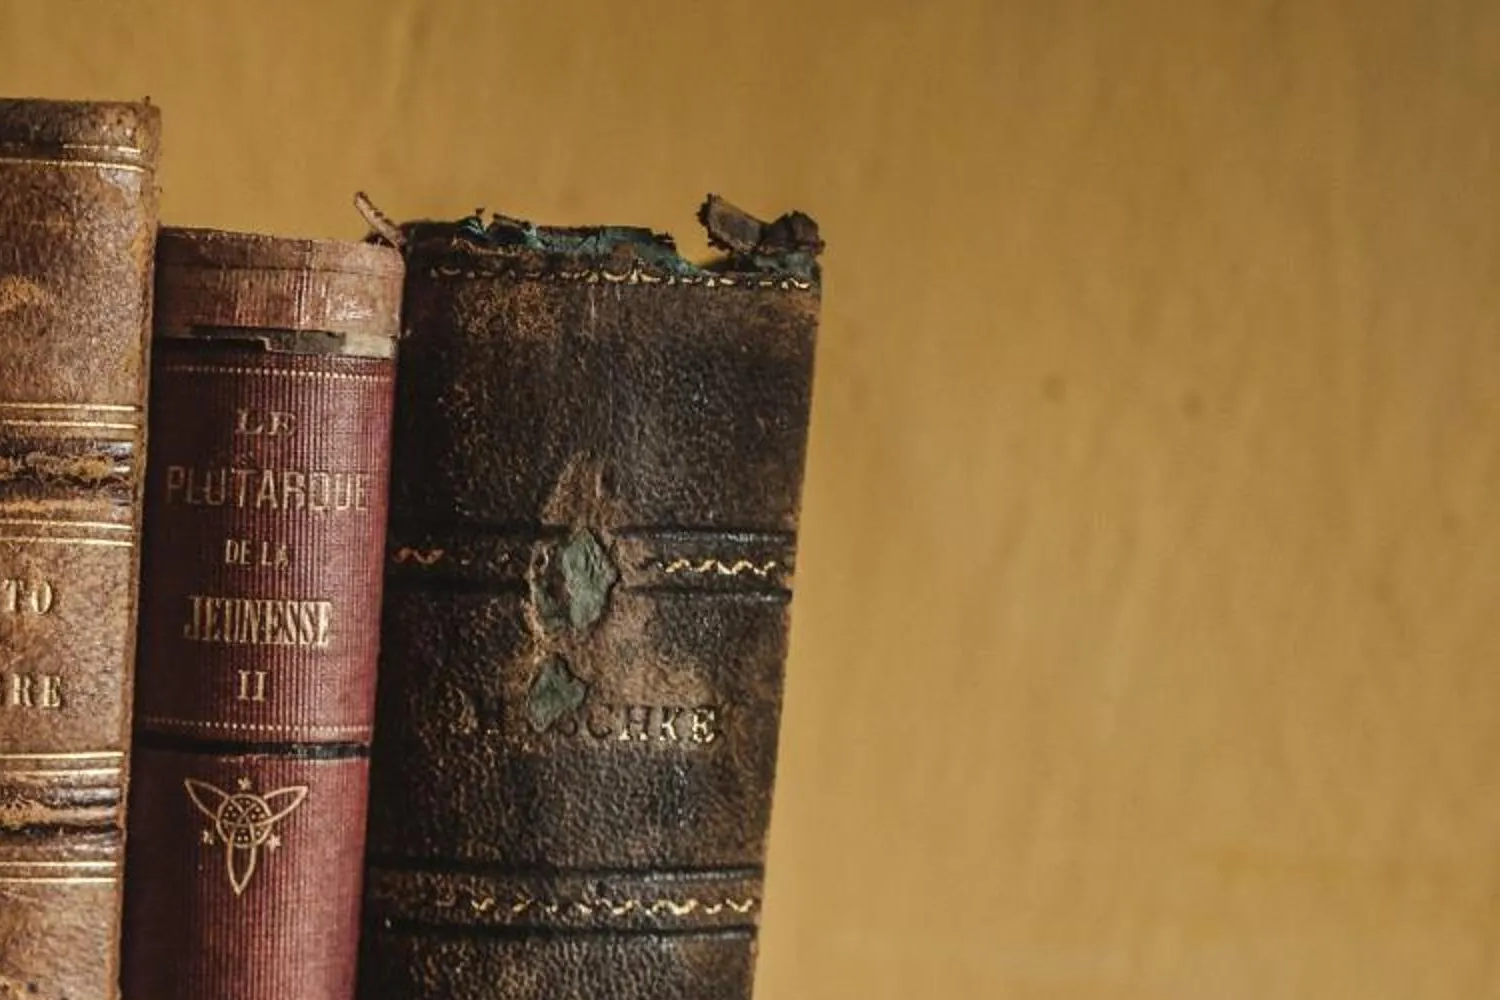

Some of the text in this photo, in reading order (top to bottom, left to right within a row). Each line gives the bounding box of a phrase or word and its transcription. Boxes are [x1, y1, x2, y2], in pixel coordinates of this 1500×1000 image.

[165, 465, 372, 512] PLUTARQUE
[224, 538, 290, 569] DE LA
[183, 595, 334, 648] JEUNESSE
[236, 668, 270, 702] II
